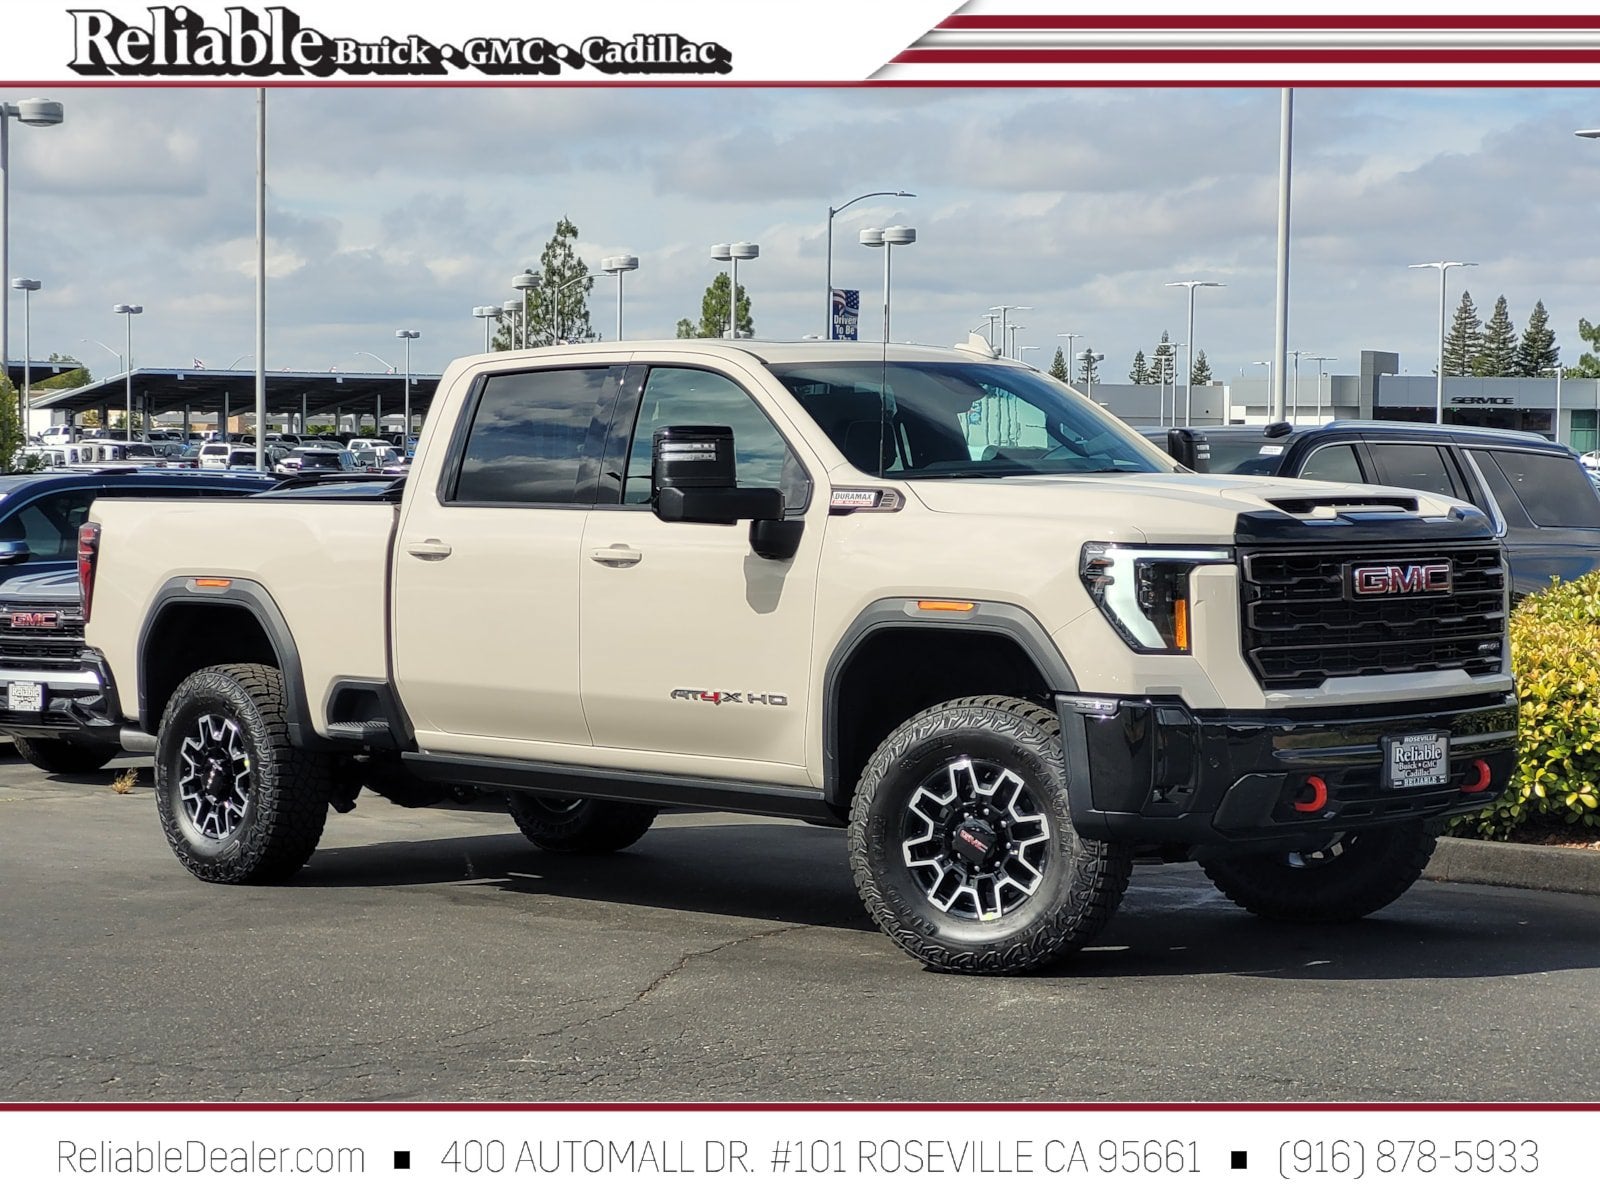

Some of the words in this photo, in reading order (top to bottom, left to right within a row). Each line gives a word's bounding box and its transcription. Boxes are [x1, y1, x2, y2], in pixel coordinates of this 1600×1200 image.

[833, 314, 857, 325] Driven
[835, 325, 844, 335] To
[845, 325, 855, 335] Be
[1450, 396, 1515, 405] SERVICE
[833, 492, 873, 501] DURAMAX
[1354, 565, 1450, 595] GMC
[11, 612, 57, 627] GMC
[670, 689, 743, 706] AT4X
[747, 692, 788, 706] HD
[1404, 735, 1437, 743] ROSEVILLE
[1395, 744, 1442, 762] Reliable
[1399, 761, 1418, 771] Buick
[1421, 760, 1438, 769] GMC
[1404, 769, 1431, 778] Cadillac
[1404, 777, 1437, 787] RELIABLE
[959, 829, 989, 853] GMC
